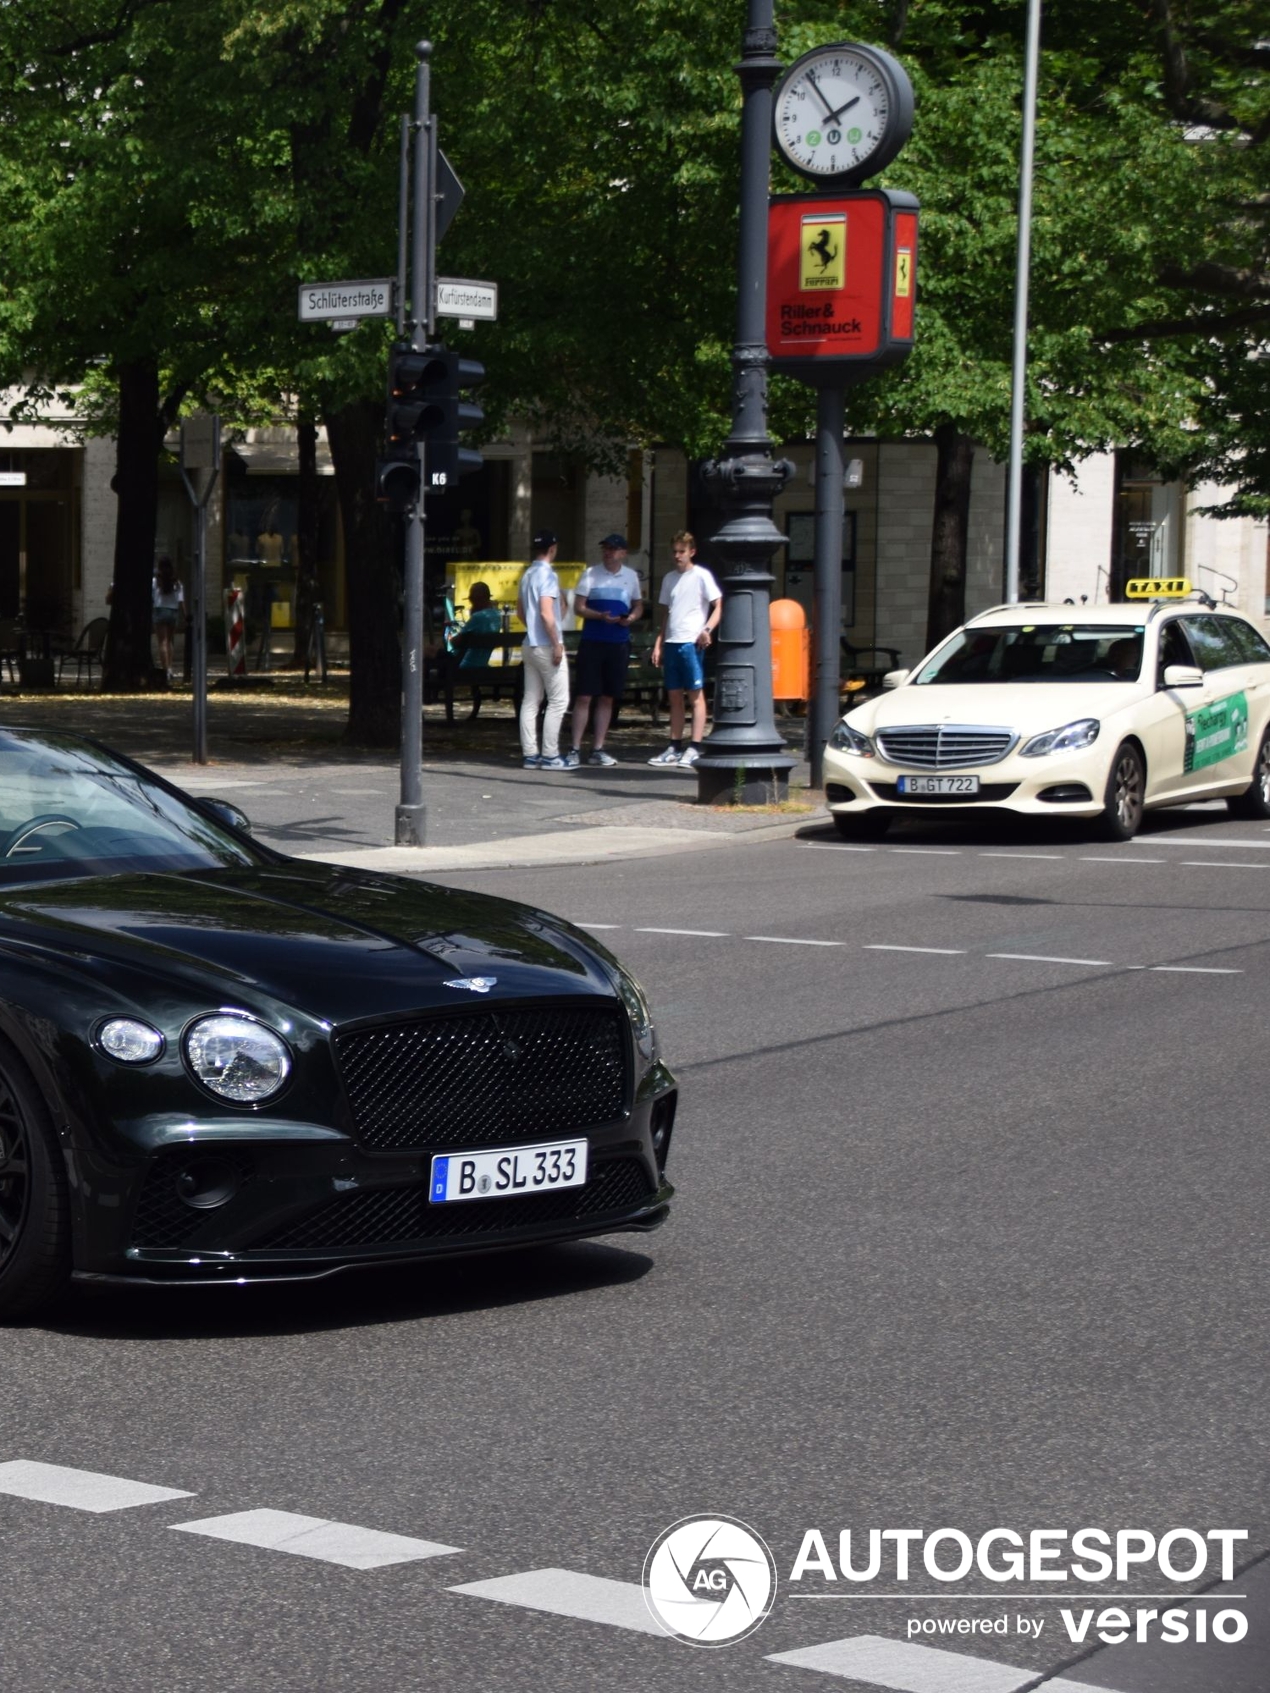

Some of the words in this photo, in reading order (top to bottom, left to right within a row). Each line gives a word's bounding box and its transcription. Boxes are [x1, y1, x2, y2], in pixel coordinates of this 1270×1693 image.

[832, 67, 841, 76] 12
[797, 92, 806, 101] 10
[792, 114, 797, 123] 9
[805, 276, 839, 287] Ferrari
[308, 290, 384, 310] Schlüterstraße
[438, 287, 492, 308] Kurfürstendamm
[781, 304, 820, 319] Riller
[823, 303, 834, 318] &
[781, 319, 862, 336] Schnauck
[432, 472, 447, 485] K6
[1135, 581, 1178, 593] TAXI
[910, 778, 918, 791] B
[927, 778, 943, 791] GT
[947, 778, 973, 791] 722
[459, 1160, 475, 1194] B
[495, 1156, 527, 1190] SL
[532, 1148, 576, 1185] 333
[436, 1183, 443, 1194] D
